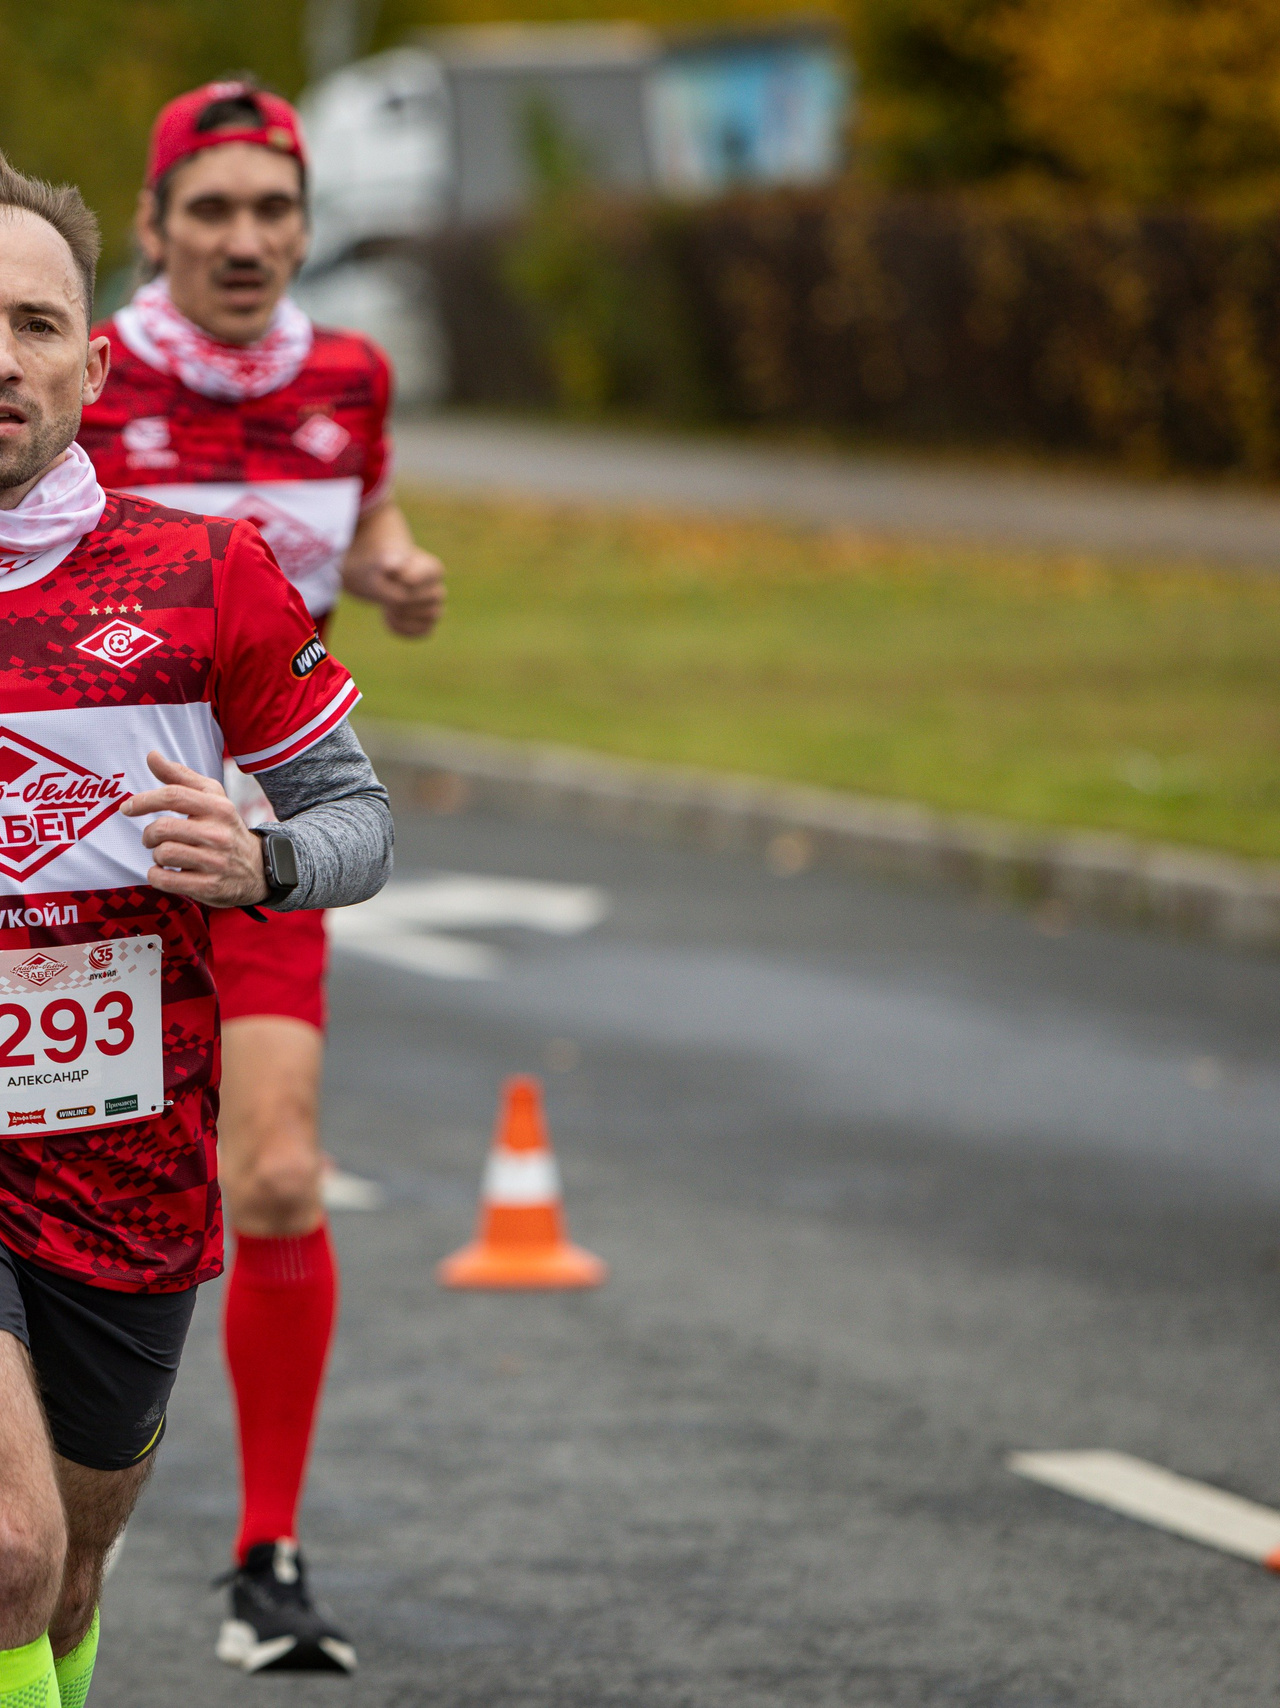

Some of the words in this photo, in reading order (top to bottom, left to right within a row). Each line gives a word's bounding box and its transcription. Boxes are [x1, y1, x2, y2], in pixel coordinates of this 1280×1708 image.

[97, 948, 114, 962] 35
[23, 970, 55, 980] ЗАБЕГ
[7, 1070, 89, 1087] АЛЕКСАНДР
[106, 1099, 136, 1109] Примавера
[59, 1108, 87, 1117] WINLINE
